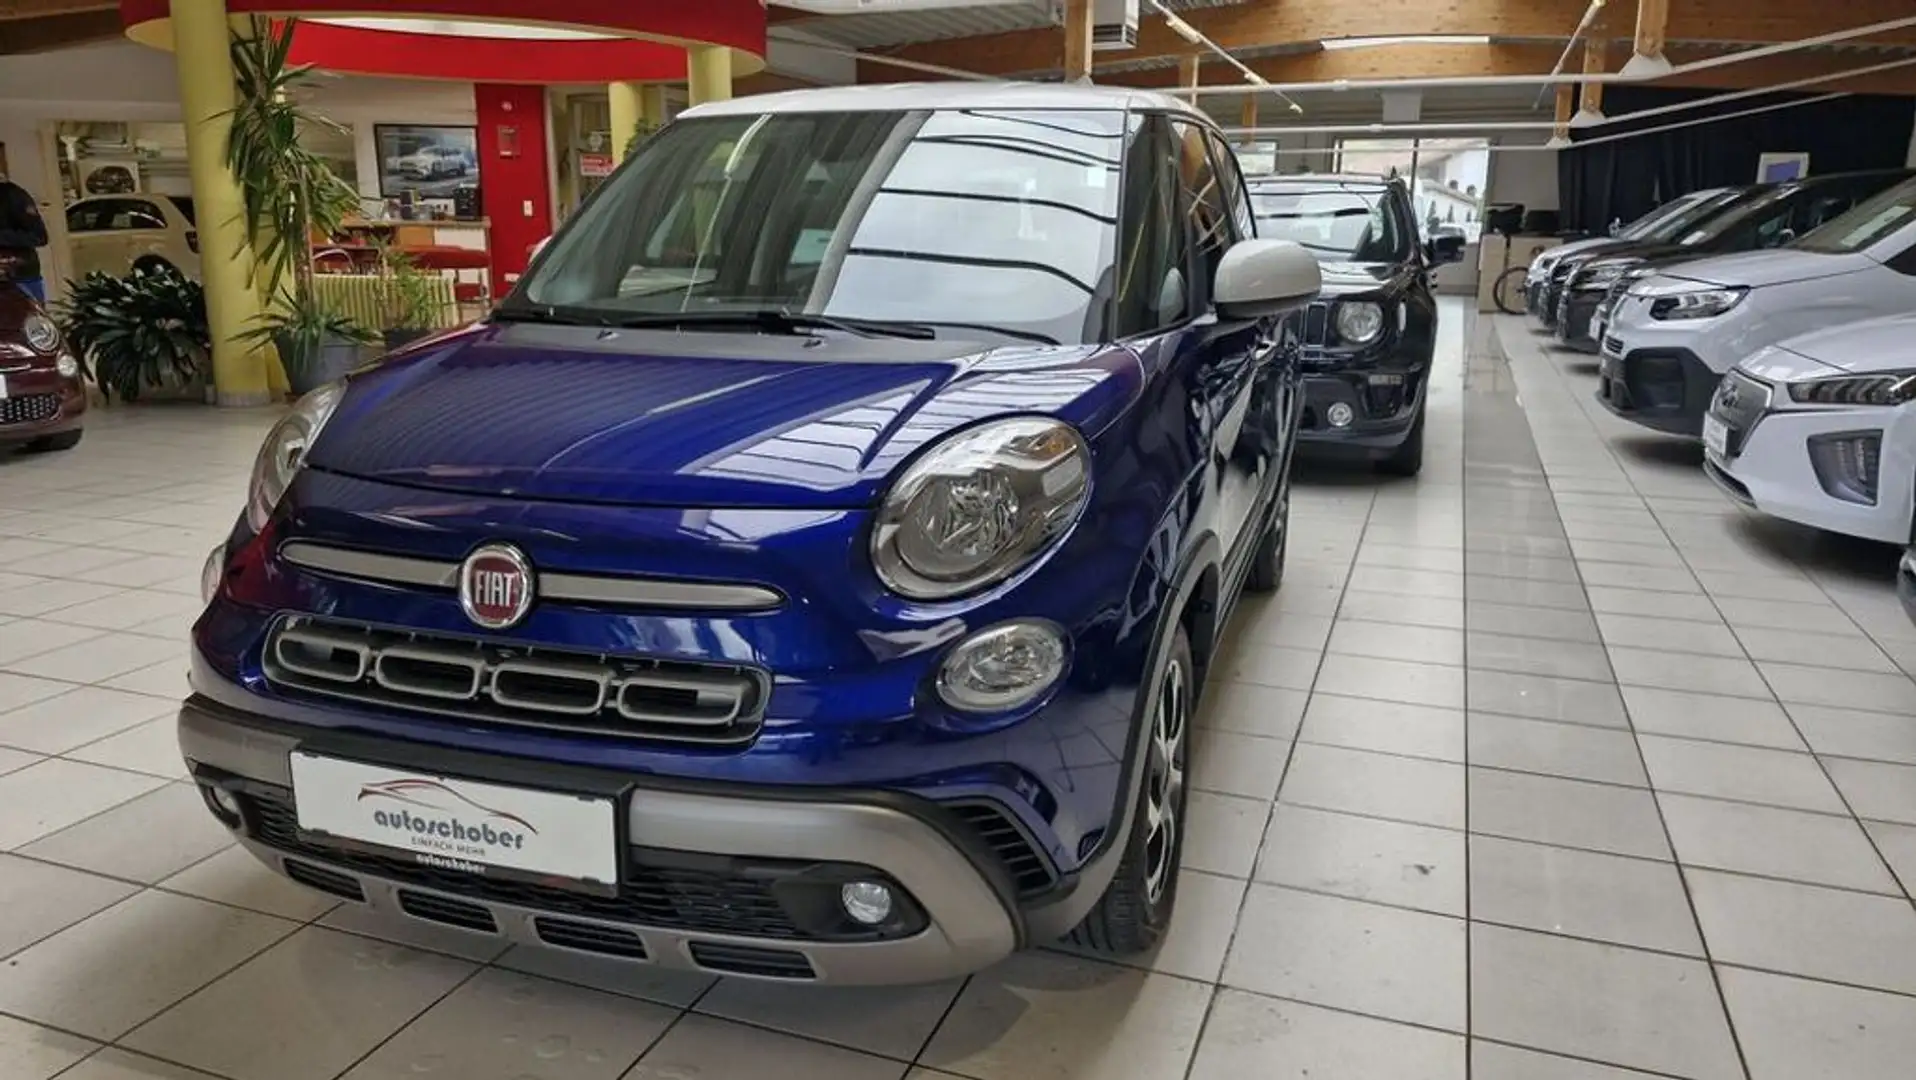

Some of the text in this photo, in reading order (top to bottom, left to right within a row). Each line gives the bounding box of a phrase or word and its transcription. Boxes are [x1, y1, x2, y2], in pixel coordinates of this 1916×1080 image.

[475, 570, 519, 607] FIAT
[374, 809, 524, 849] autoschober
[411, 835, 486, 857] EINFACH MEHR
[415, 852, 487, 875] autoschober
